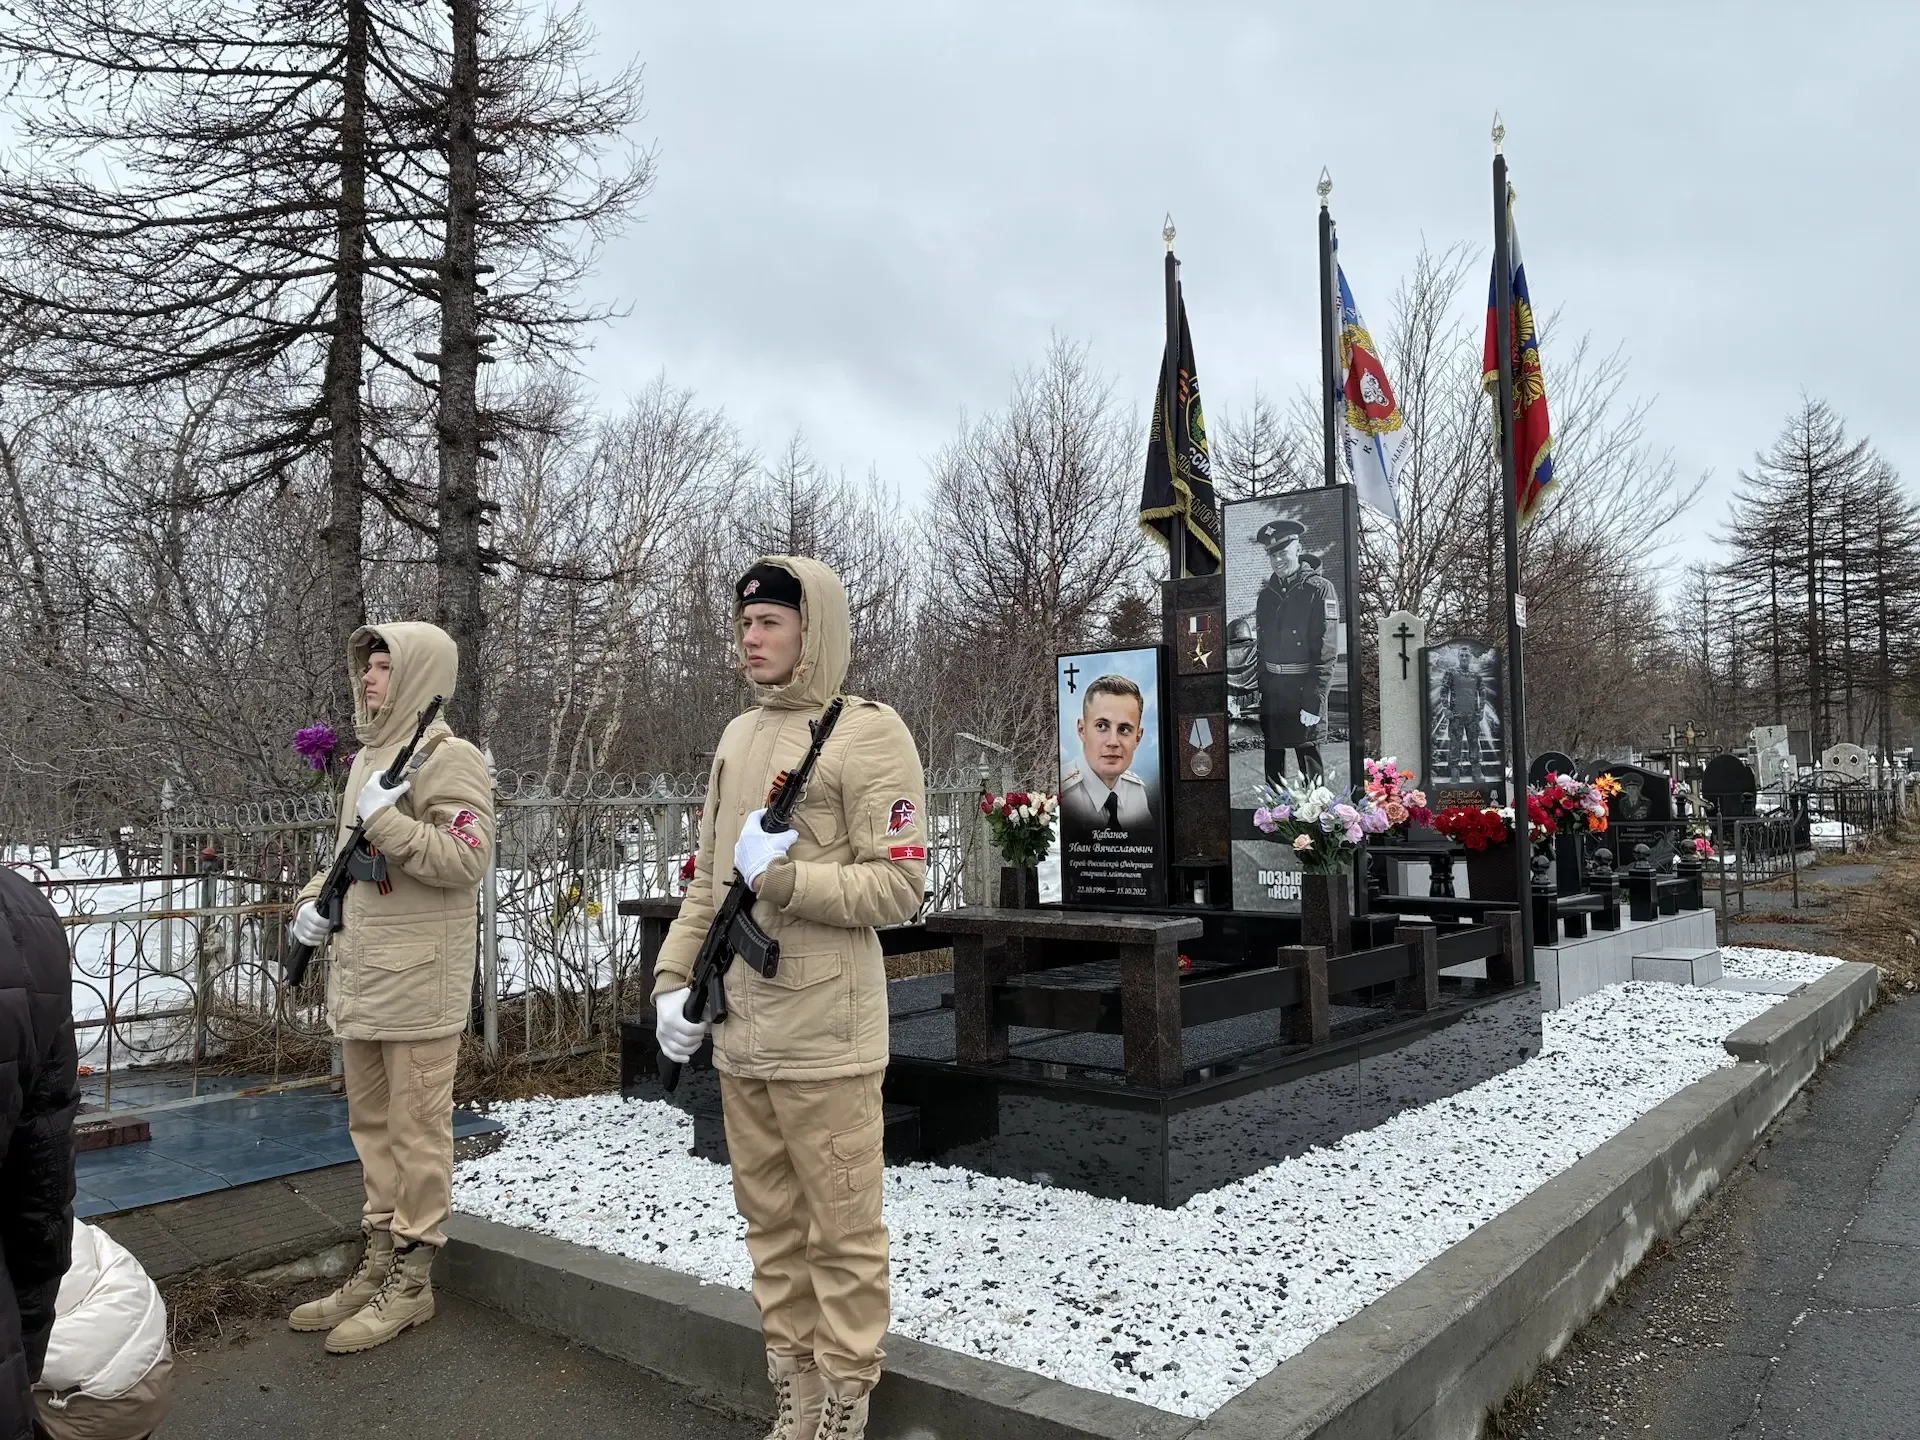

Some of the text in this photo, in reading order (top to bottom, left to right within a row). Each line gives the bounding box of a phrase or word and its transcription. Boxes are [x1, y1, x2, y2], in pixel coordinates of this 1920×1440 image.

[1440, 790, 1482, 799] САПРЫКА
[1092, 828, 1128, 840] Кабанов
[1068, 842, 1154, 854] Иван Вячеславович
[1258, 870, 1303, 886] ПОЗЫВ
